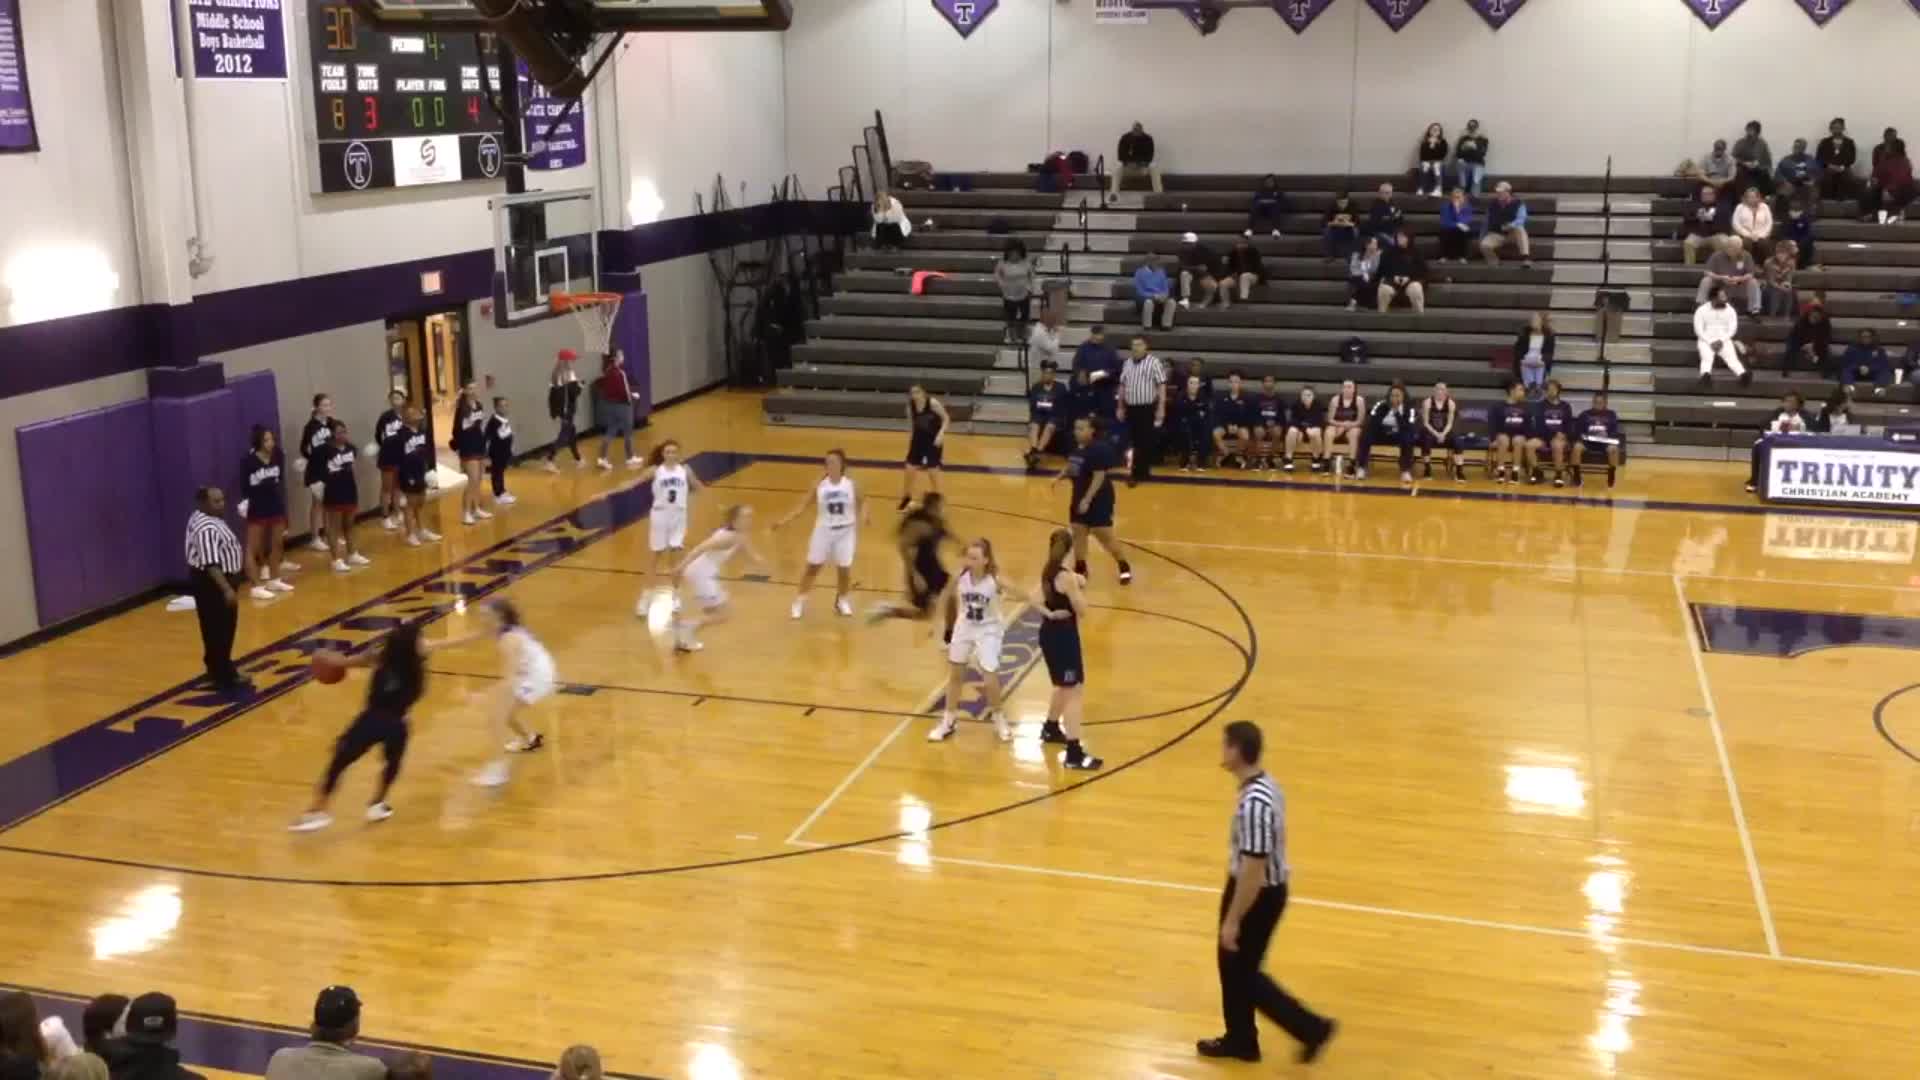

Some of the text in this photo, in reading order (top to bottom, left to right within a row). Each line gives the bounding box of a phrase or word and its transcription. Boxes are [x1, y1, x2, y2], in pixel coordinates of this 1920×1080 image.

[196, 12, 264, 30] Middle School
[954, 2, 975, 24] T
[322, 7, 356, 50] 30
[199, 32, 265, 52] Boys Basketball
[214, 54, 253, 73] 2012
[396, 79, 425, 91] PLAYER
[364, 97, 378, 129] 3
[467, 96, 481, 124] 4
[1776, 460, 1920, 489] TRINITY
[1781, 487, 1910, 501] CHRISTIAN ACADEMY
